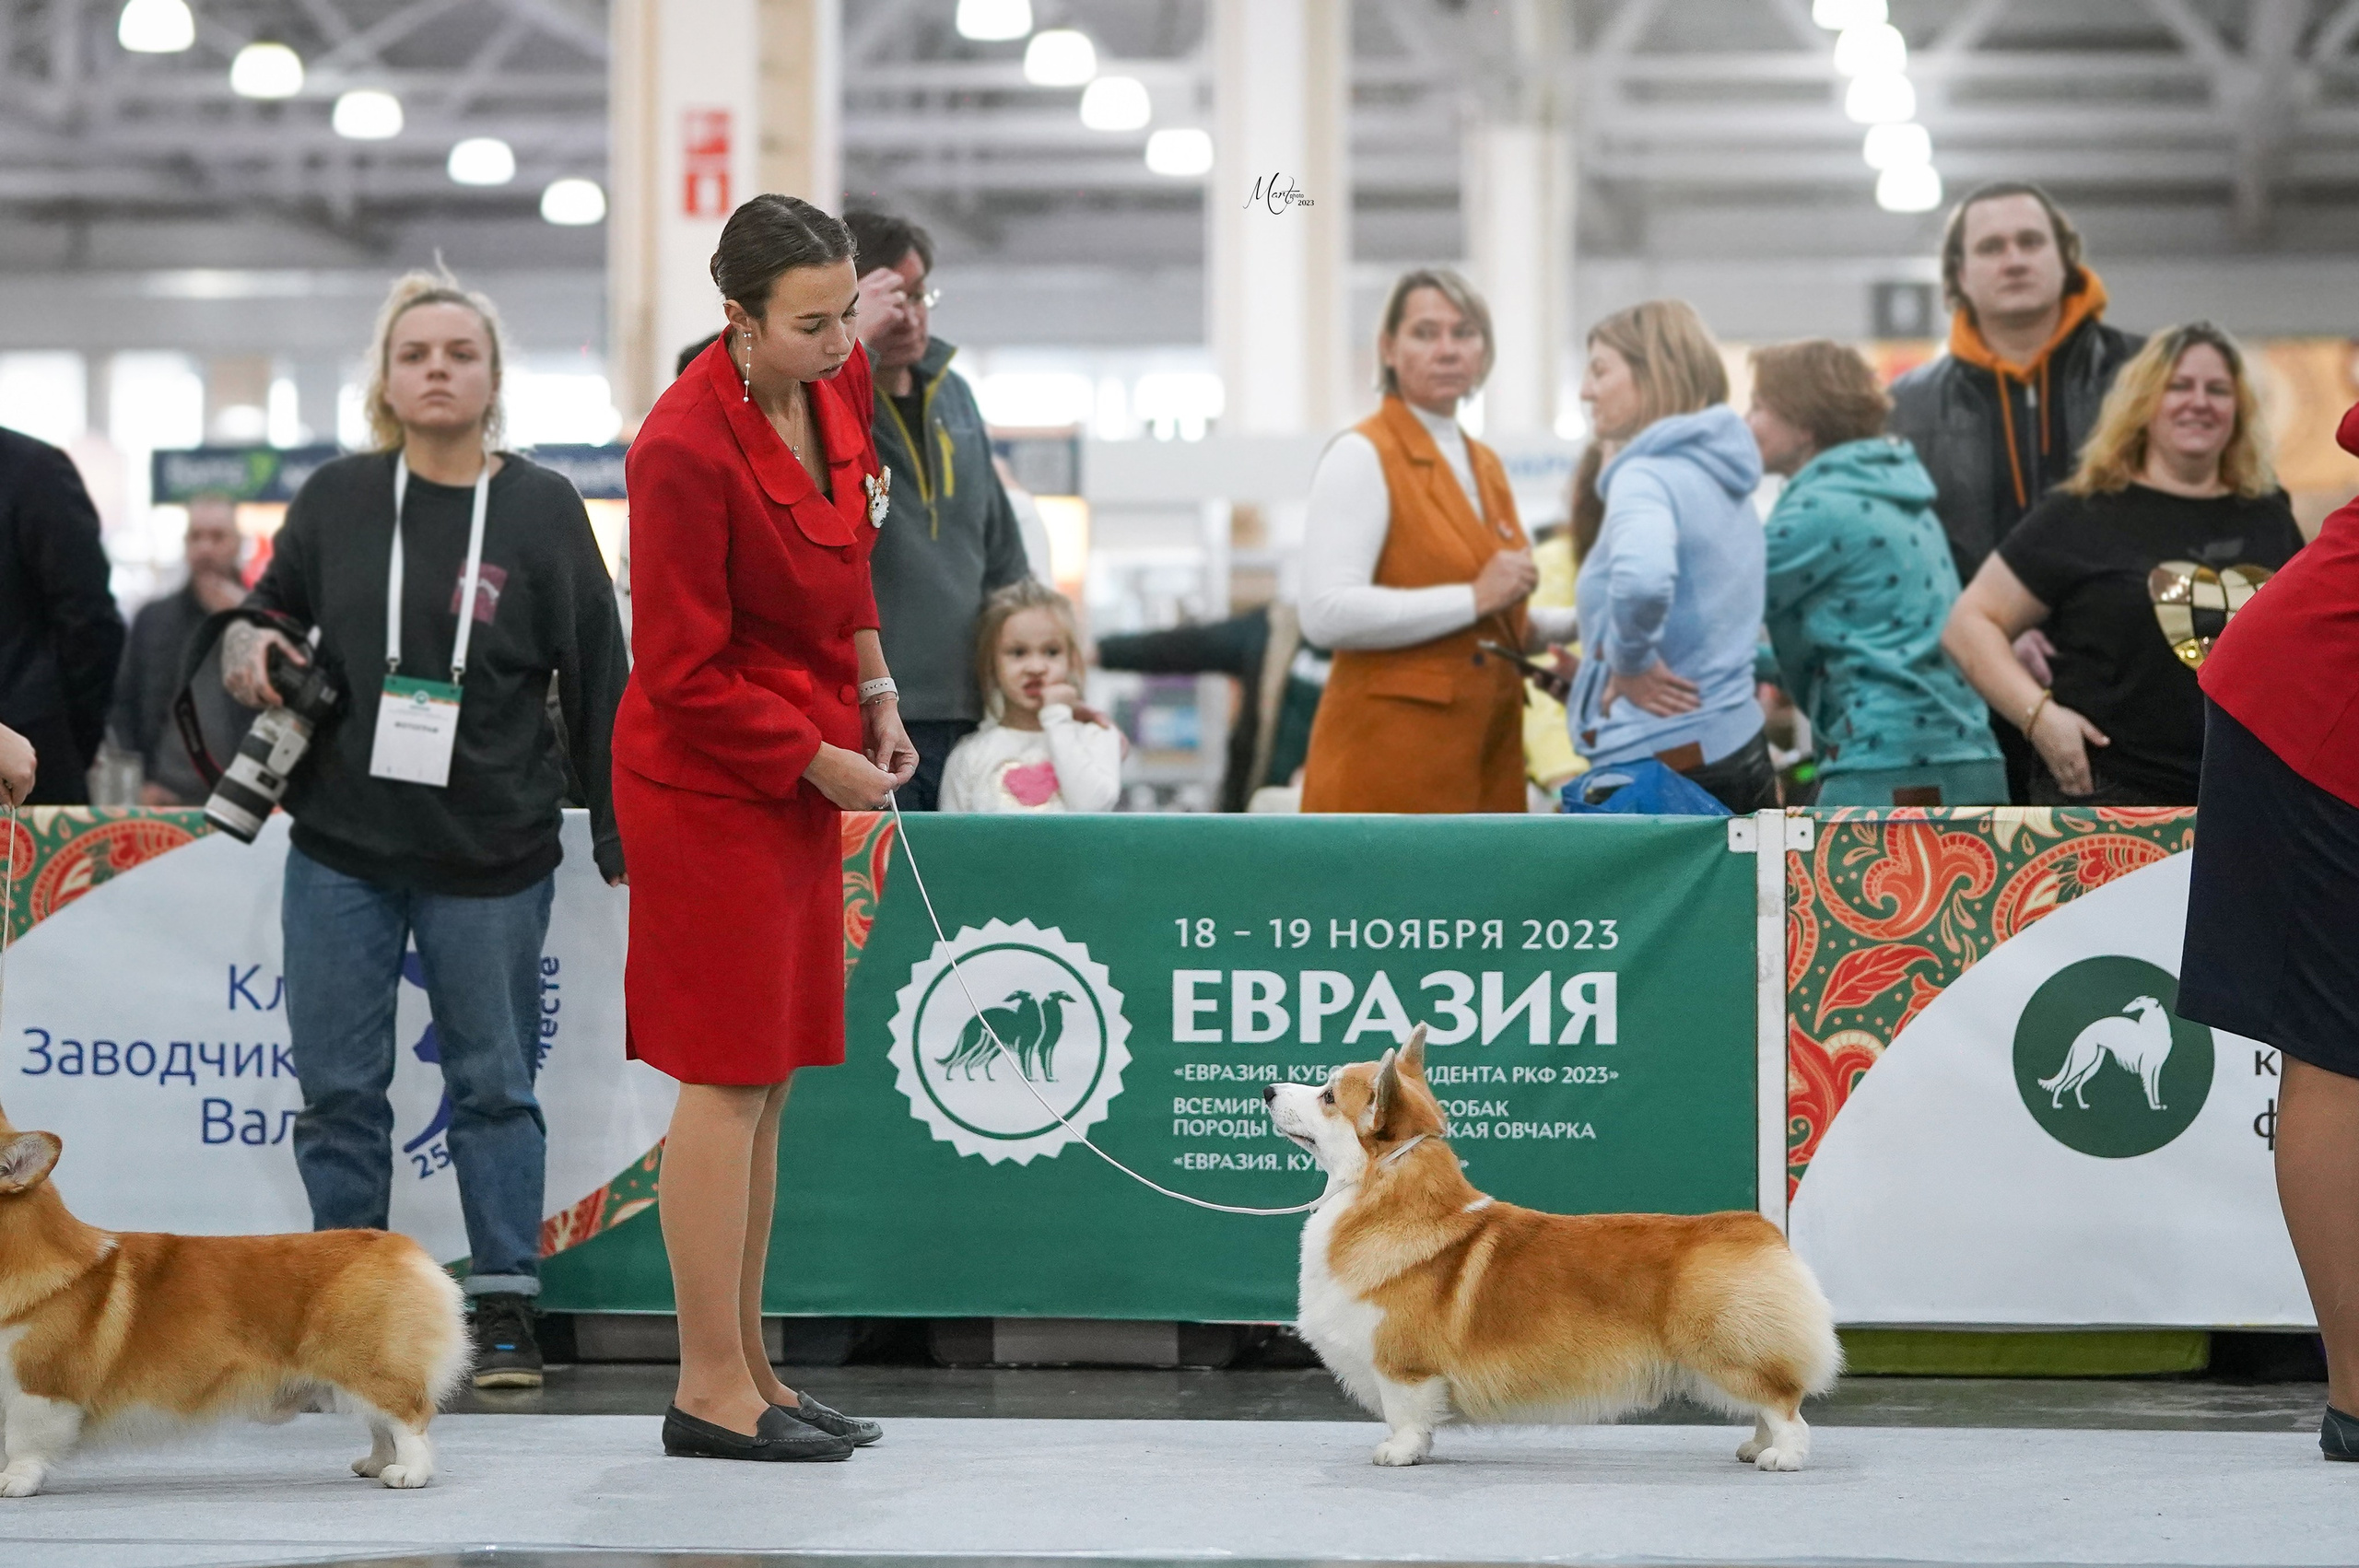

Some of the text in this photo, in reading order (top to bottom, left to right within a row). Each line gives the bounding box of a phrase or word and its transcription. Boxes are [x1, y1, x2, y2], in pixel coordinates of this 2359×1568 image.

[1175, 918, 1216, 949] 18
[1269, 918, 1311, 949] 19
[1330, 918, 1503, 950] НОЯБРЯ
[1521, 919, 1619, 950] 2023
[1172, 969, 1618, 1047] ЕВРАЗИЯ
[1173, 1063, 1282, 1082] «ЕВРАЗИЯ.
[1512, 1066, 1556, 1083] РКФ
[1561, 1066, 1619, 1083] 2023»
[1173, 1118, 1267, 1139] ПОРОДЫ
[1494, 1121, 1597, 1139] ОВЧАРКА
[1173, 1153, 1282, 1170] «ЕВРАЗИЯ.
